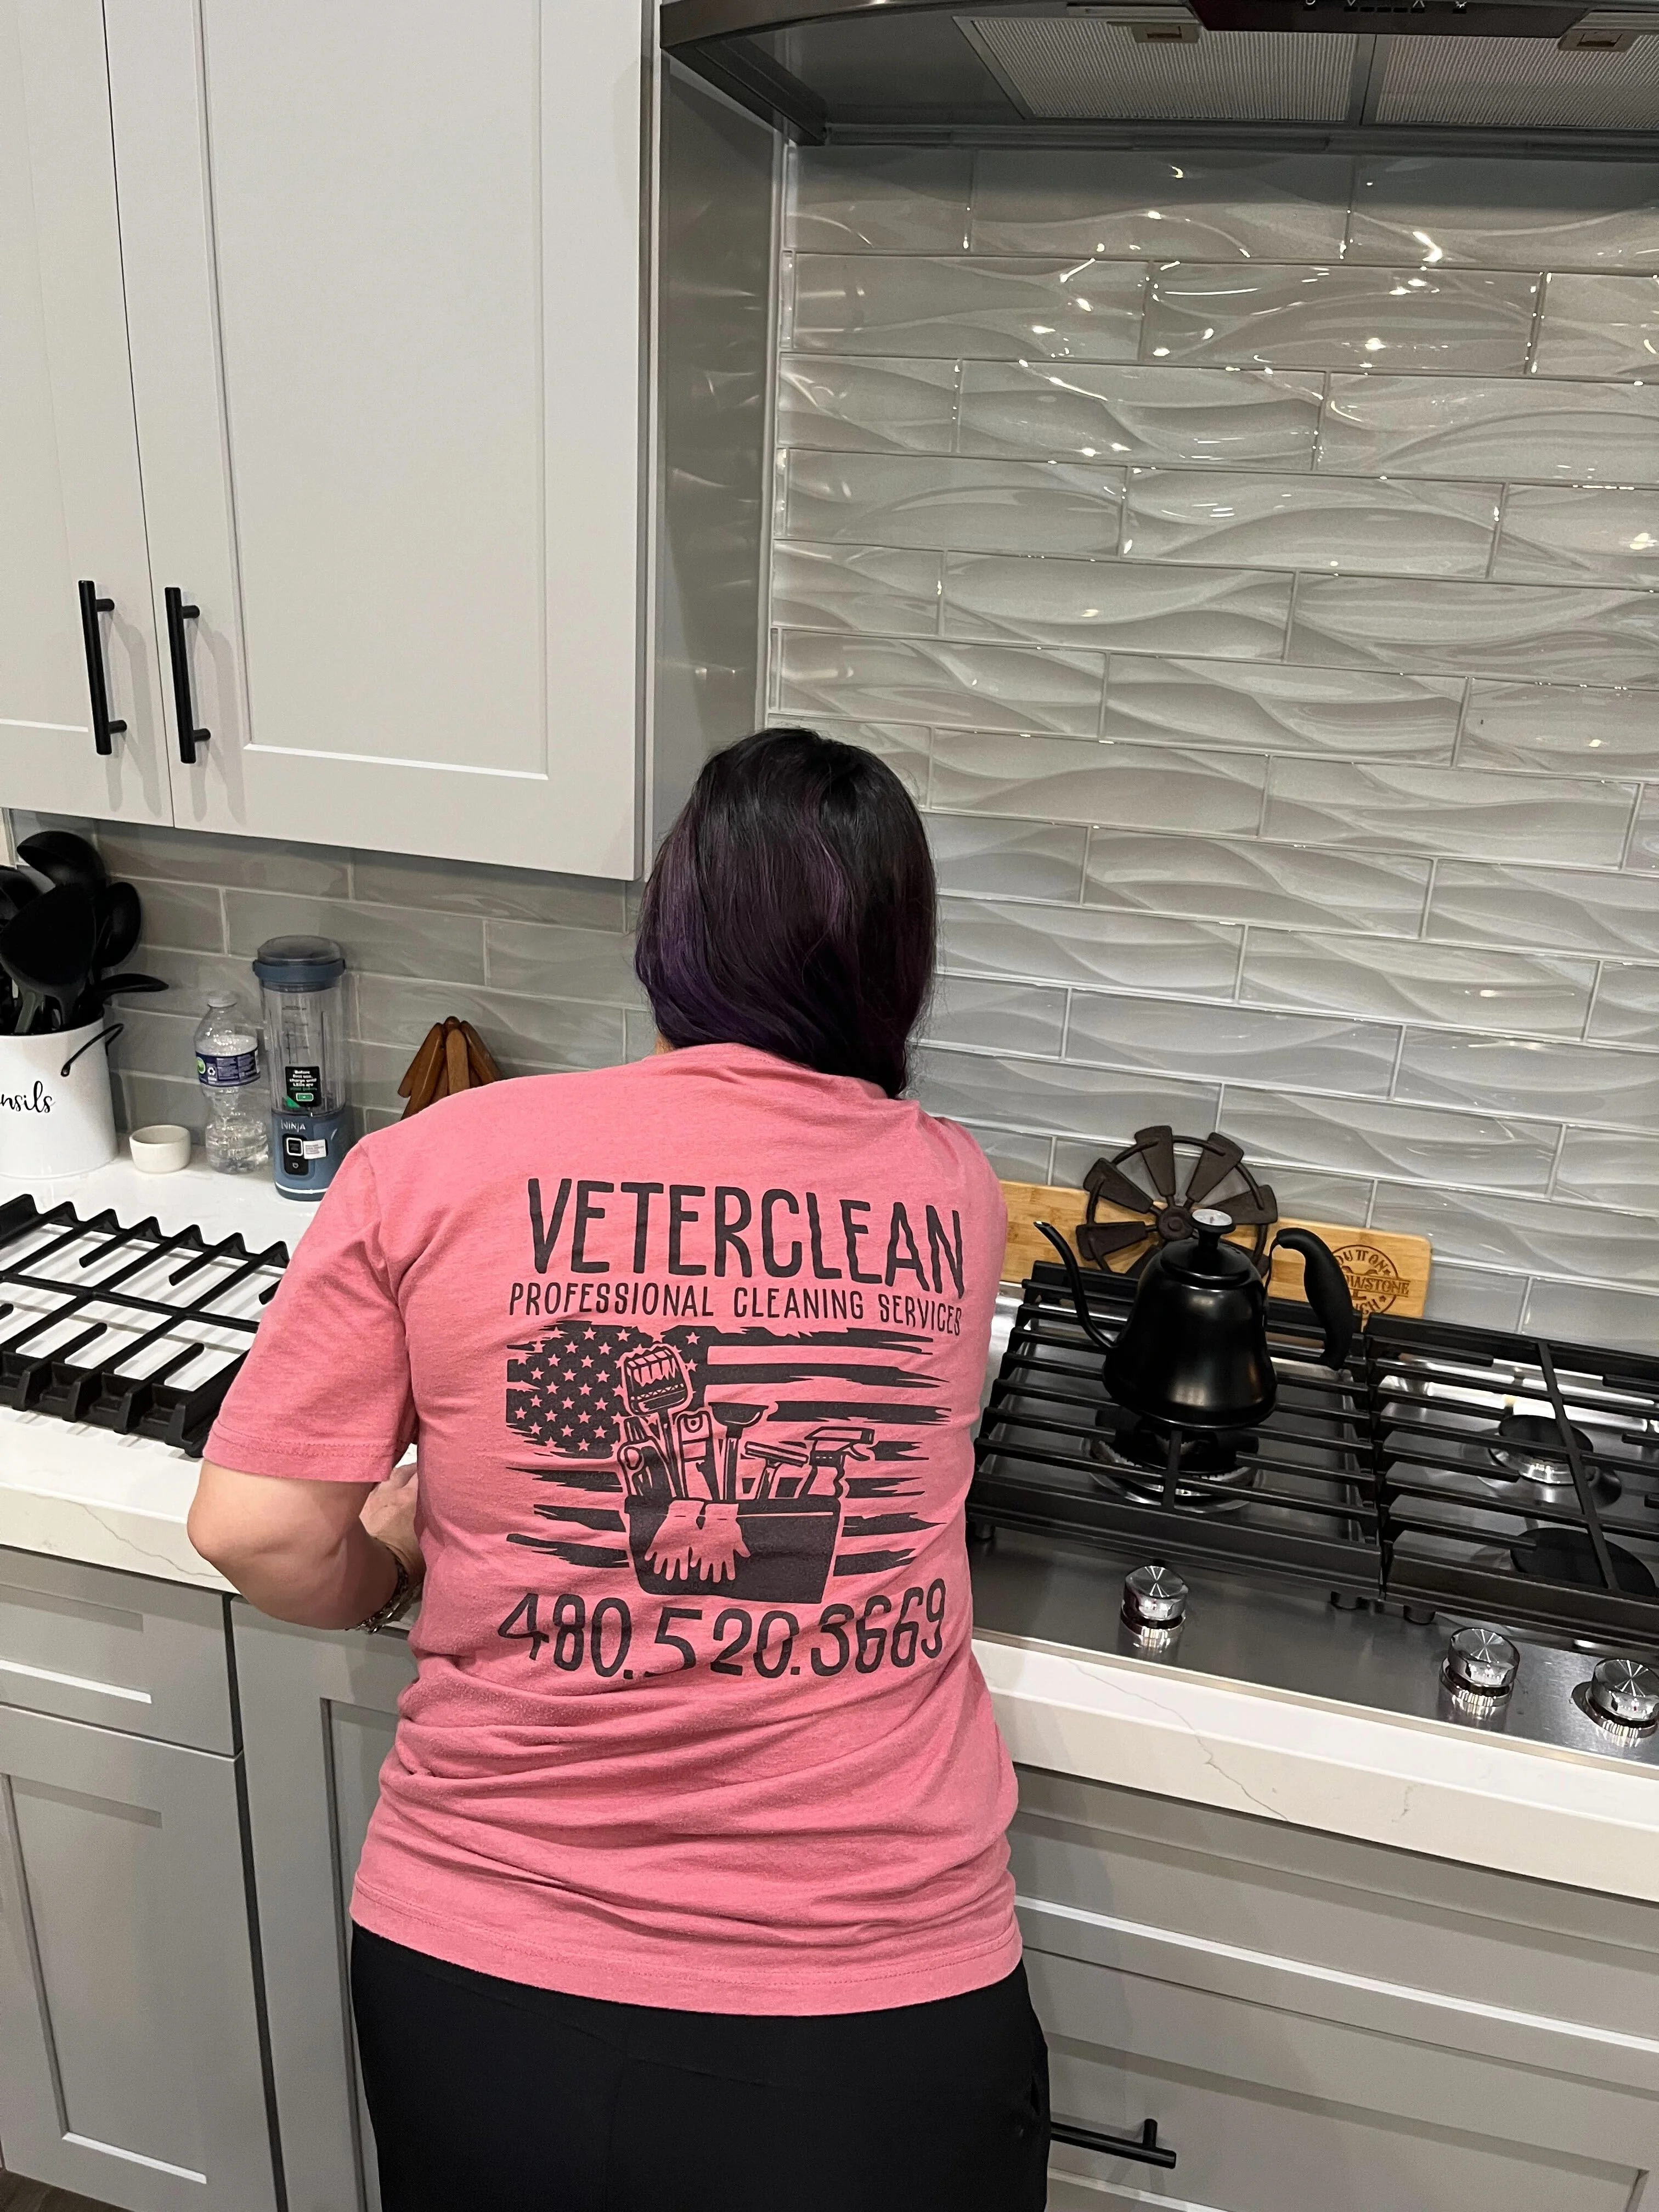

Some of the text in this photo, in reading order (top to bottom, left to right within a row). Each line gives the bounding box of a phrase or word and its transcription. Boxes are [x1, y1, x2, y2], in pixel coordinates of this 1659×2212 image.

[0, 1080, 55, 1113] nsils
[281, 1119, 306, 1133] NINJA
[527, 1177, 966, 1300] VETERCLEAN
[509, 1282, 962, 1336] PROFESSIONAL CLEANING SERVICES
